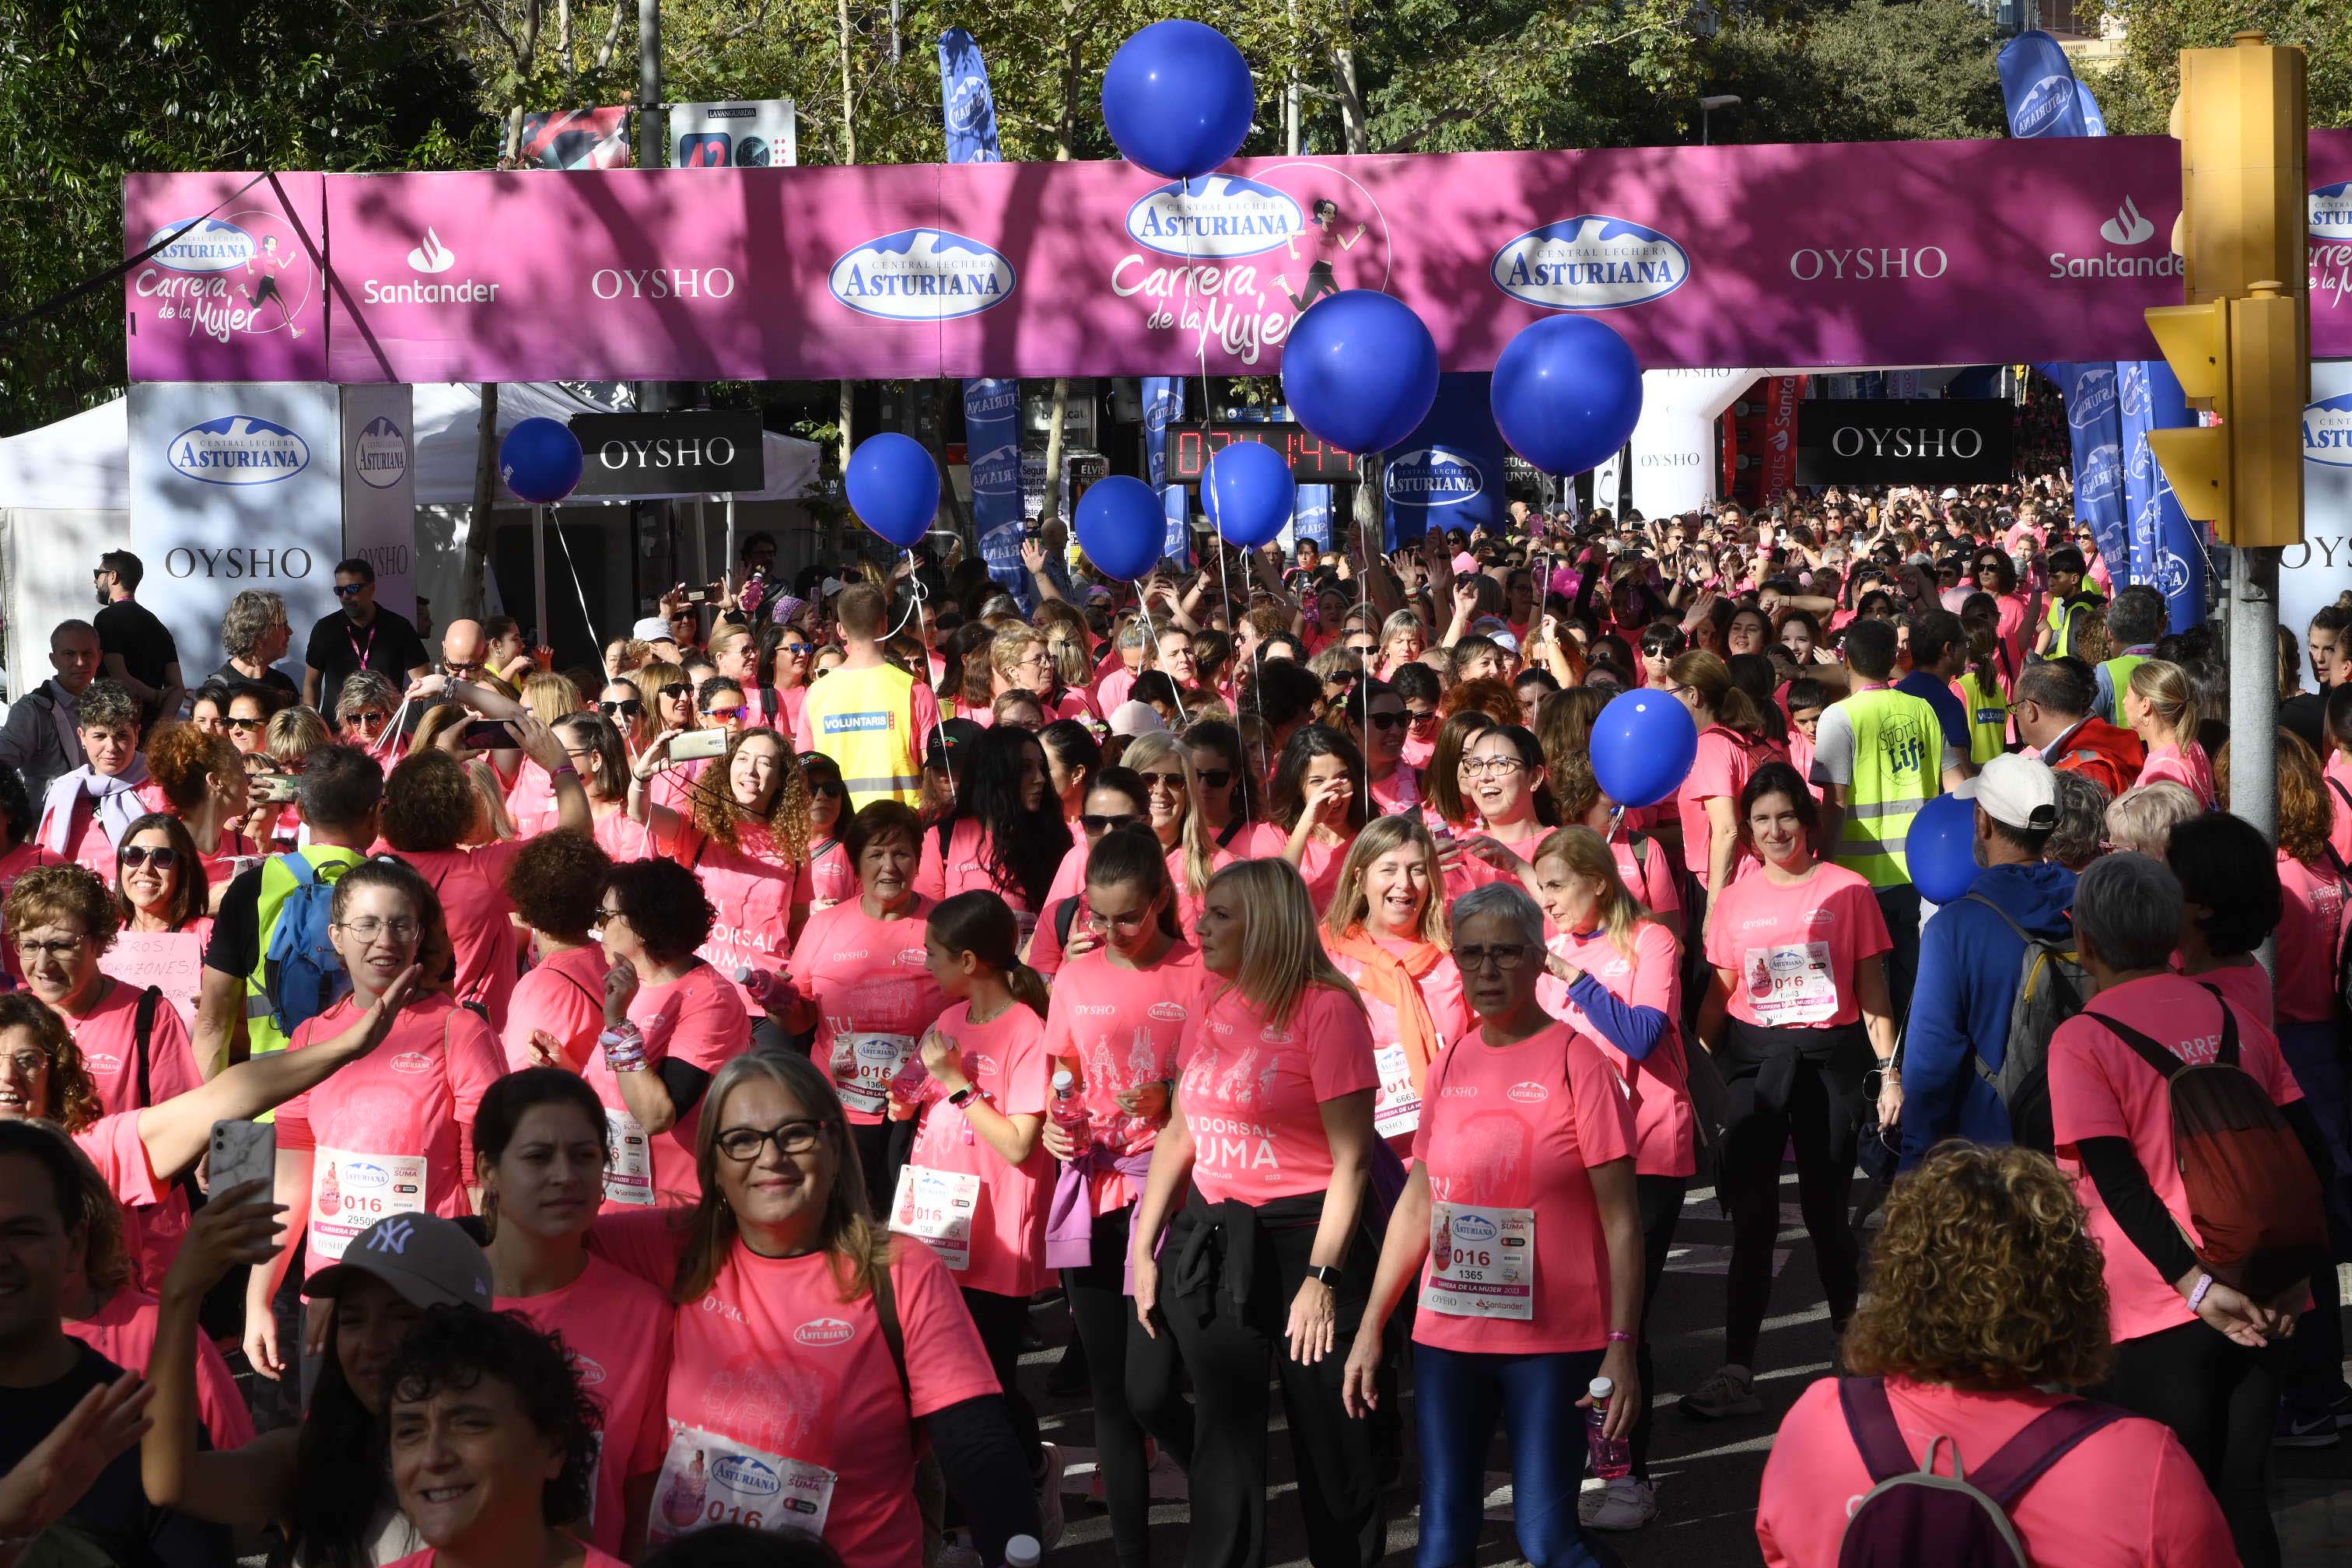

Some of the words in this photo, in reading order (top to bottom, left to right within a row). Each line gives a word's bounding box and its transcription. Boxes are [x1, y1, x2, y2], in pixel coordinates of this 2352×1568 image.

[1140, 206, 1289, 236] ASTURIANA
[1537, 247, 1598, 258] CENTRAL
[1605, 246, 1668, 257] LECHERA
[872, 261, 930, 269] CENTRAL
[1507, 252, 1674, 286] ASTURIANA
[1790, 246, 1948, 281] OYSHO
[843, 263, 1001, 296] ASTURIANA
[1111, 254, 1258, 297] Carrera
[135, 268, 226, 298] Carrera
[592, 268, 734, 299] OYSHO
[364, 278, 500, 304] Santander
[158, 299, 175, 319] de
[179, 299, 191, 319] la
[189, 295, 261, 343] Mujer
[1147, 299, 1174, 329] de
[1181, 298, 1199, 329] la
[250, 439, 294, 447] LECHERA
[1832, 426, 1982, 457] OYSHO
[180, 441, 299, 467] ASTURIANA
[359, 443, 404, 471] ASTURIANA
[600, 436, 735, 470] OYSHO
[1641, 453, 1700, 467] OYSHO
[1081, 464, 1104, 475] ELVIS
[1389, 472, 1476, 493] ASTURIANA
[165, 548, 312, 579] OYSHO
[824, 716, 887, 729] VOLUNTARIS
[1879, 719, 1917, 751] Sport
[1889, 737, 1925, 773] Life
[1743, 917, 1778, 929] OYSHO
[834, 949, 868, 962] OYSHO
[1773, 959, 1802, 968] ASTURIANA
[1775, 975, 1804, 989] 016
[1075, 1005, 1115, 1015] OYSHO
[861, 1046, 895, 1056] ASTURIANA
[860, 1066, 891, 1079] 016
[1396, 1092, 1416, 1104] 6663
[1440, 1086, 1478, 1098] OYSHO
[1200, 1117, 1276, 1138] DORSAL
[345, 1171, 386, 1183] ASTURIANA
[345, 1195, 382, 1213] 016
[917, 1207, 943, 1221] 016
[321, 1225, 348, 1235] CARRERA
[920, 1225, 934, 1234] 1368
[1455, 1223, 1493, 1237] ASTURIANA
[1454, 1248, 1491, 1266] 016
[1459, 1269, 1482, 1280] 1365
[1432, 1295, 1457, 1306] OYSHO
[1486, 1300, 1523, 1311] Santander
[798, 1327, 849, 1340] ASTURIANA
[716, 1463, 775, 1493] ASTURIANA
[788, 1477, 820, 1492] SUMA
[707, 1500, 764, 1530] 016
